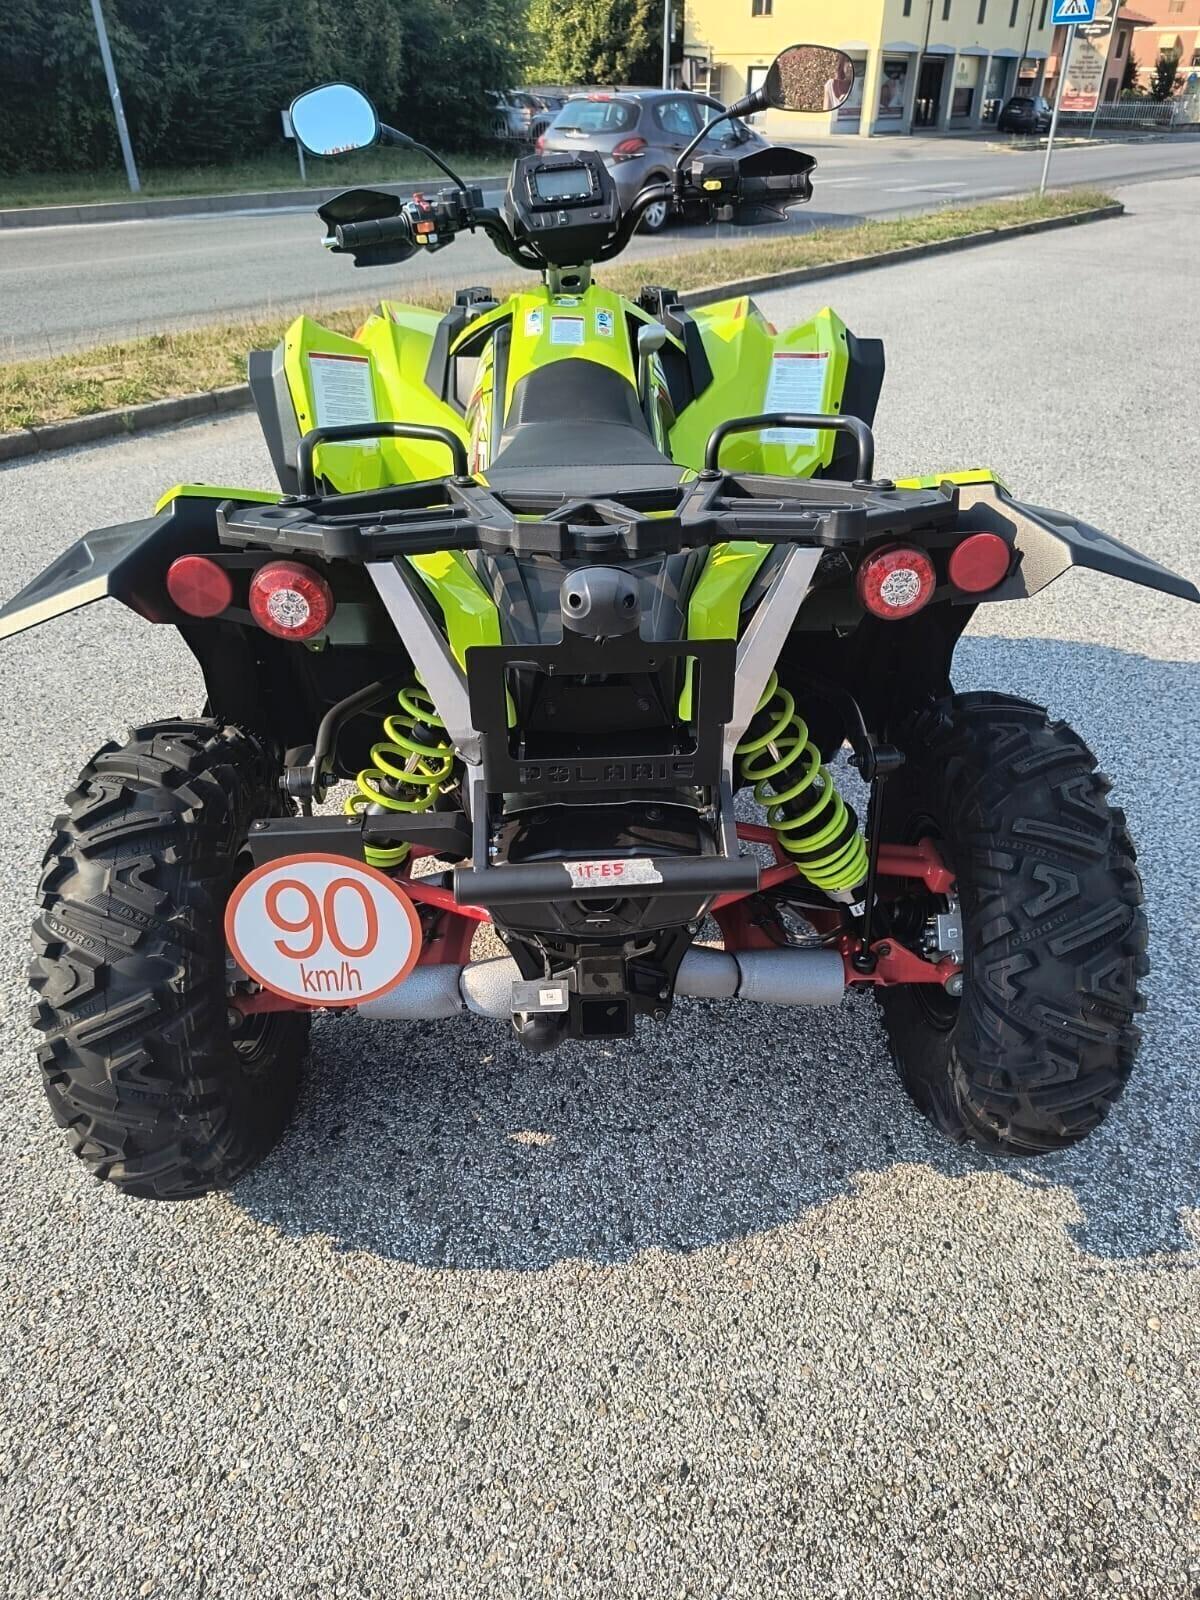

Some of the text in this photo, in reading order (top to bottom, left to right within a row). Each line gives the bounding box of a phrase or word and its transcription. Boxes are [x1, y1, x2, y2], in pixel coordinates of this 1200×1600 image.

[519, 762, 695, 783] POLARIS
[265, 877, 378, 959] 90
[300, 961, 362, 992] km/h
